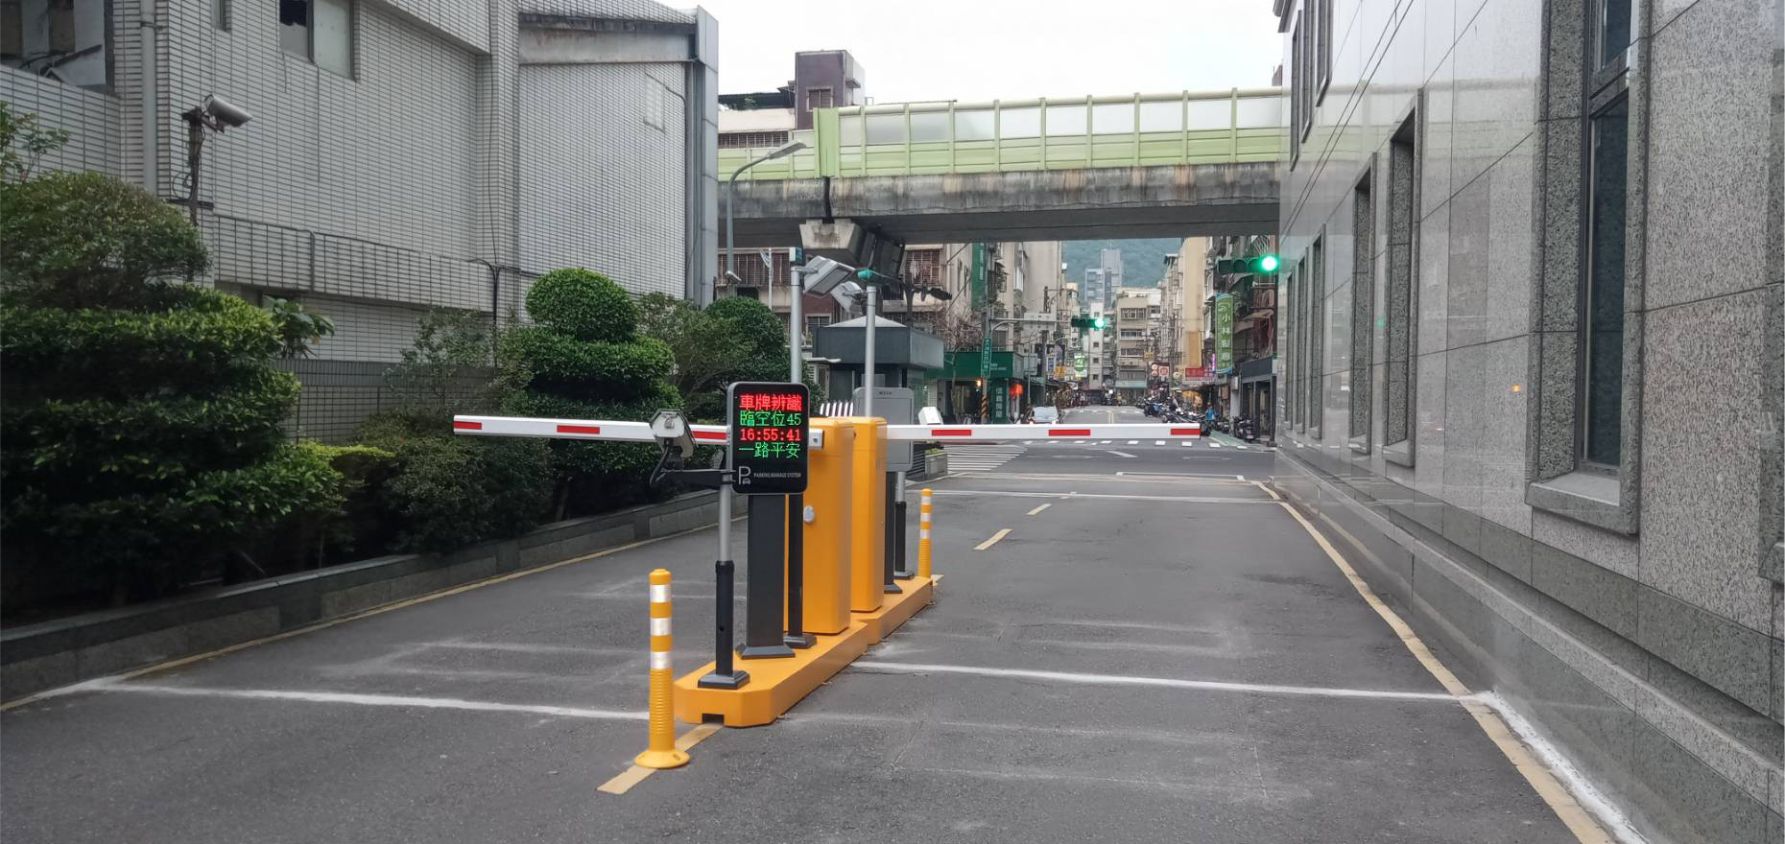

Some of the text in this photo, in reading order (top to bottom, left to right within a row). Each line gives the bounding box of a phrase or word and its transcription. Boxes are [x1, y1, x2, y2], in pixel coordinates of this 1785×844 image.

[739, 394, 802, 411] 車牌辨識
[740, 410, 802, 426] 臨空位45
[740, 429, 801, 441] 16:55:41
[739, 442, 801, 459] 一路平安
